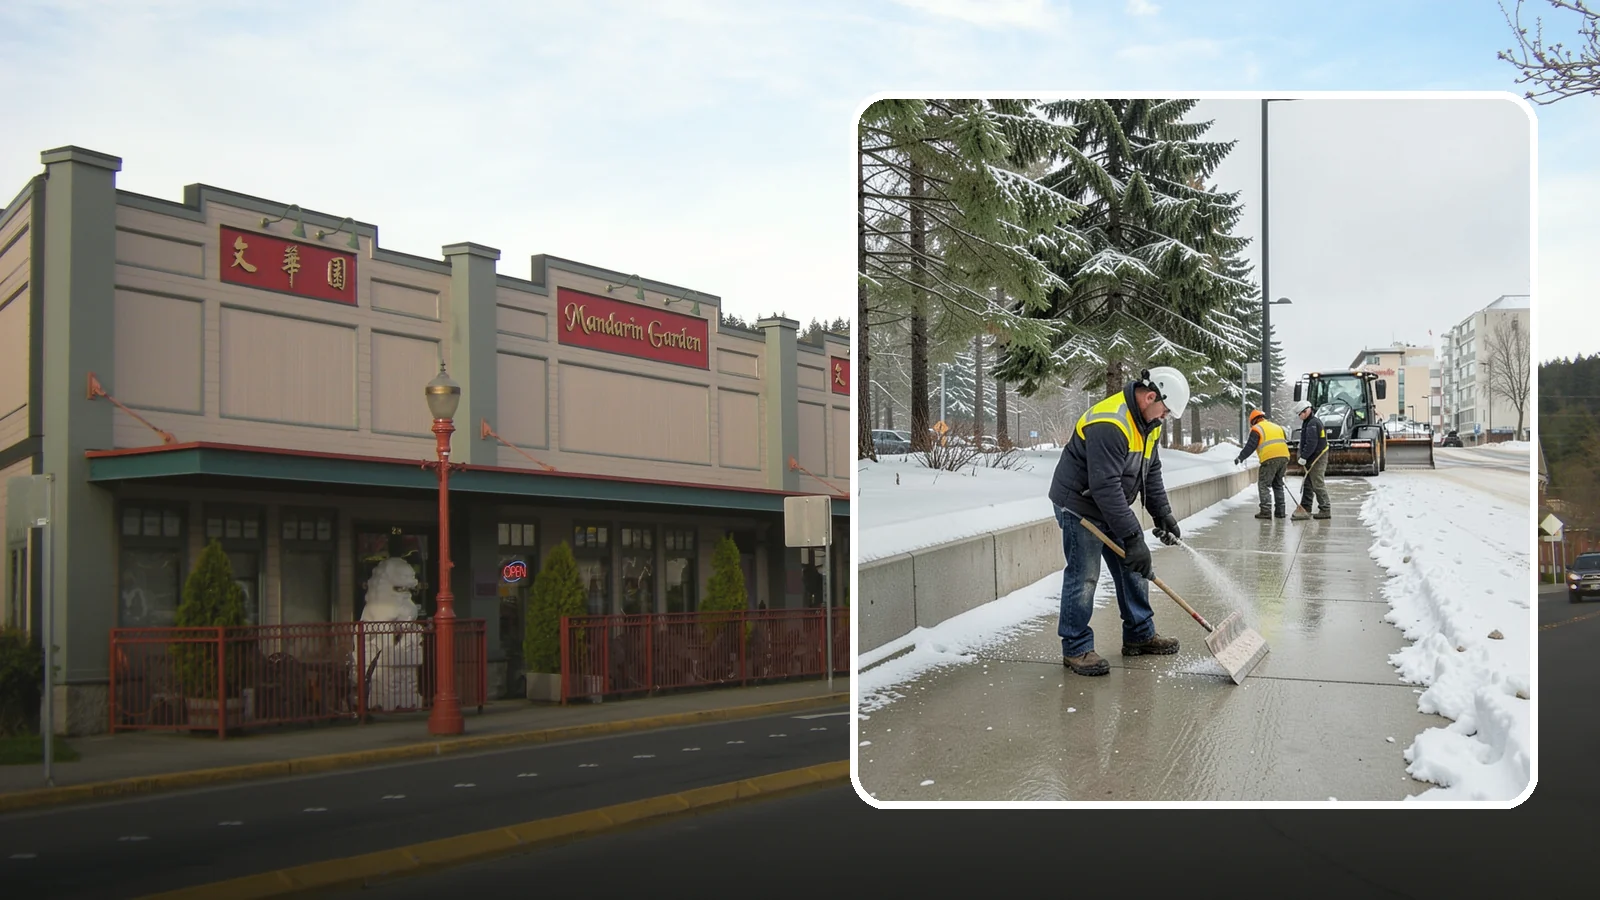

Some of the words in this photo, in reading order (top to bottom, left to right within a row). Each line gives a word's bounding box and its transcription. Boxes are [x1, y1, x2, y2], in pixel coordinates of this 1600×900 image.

[565, 302, 644, 341] Mandarin
[648, 320, 702, 352] Garden
[503, 565, 527, 578] OPEN
